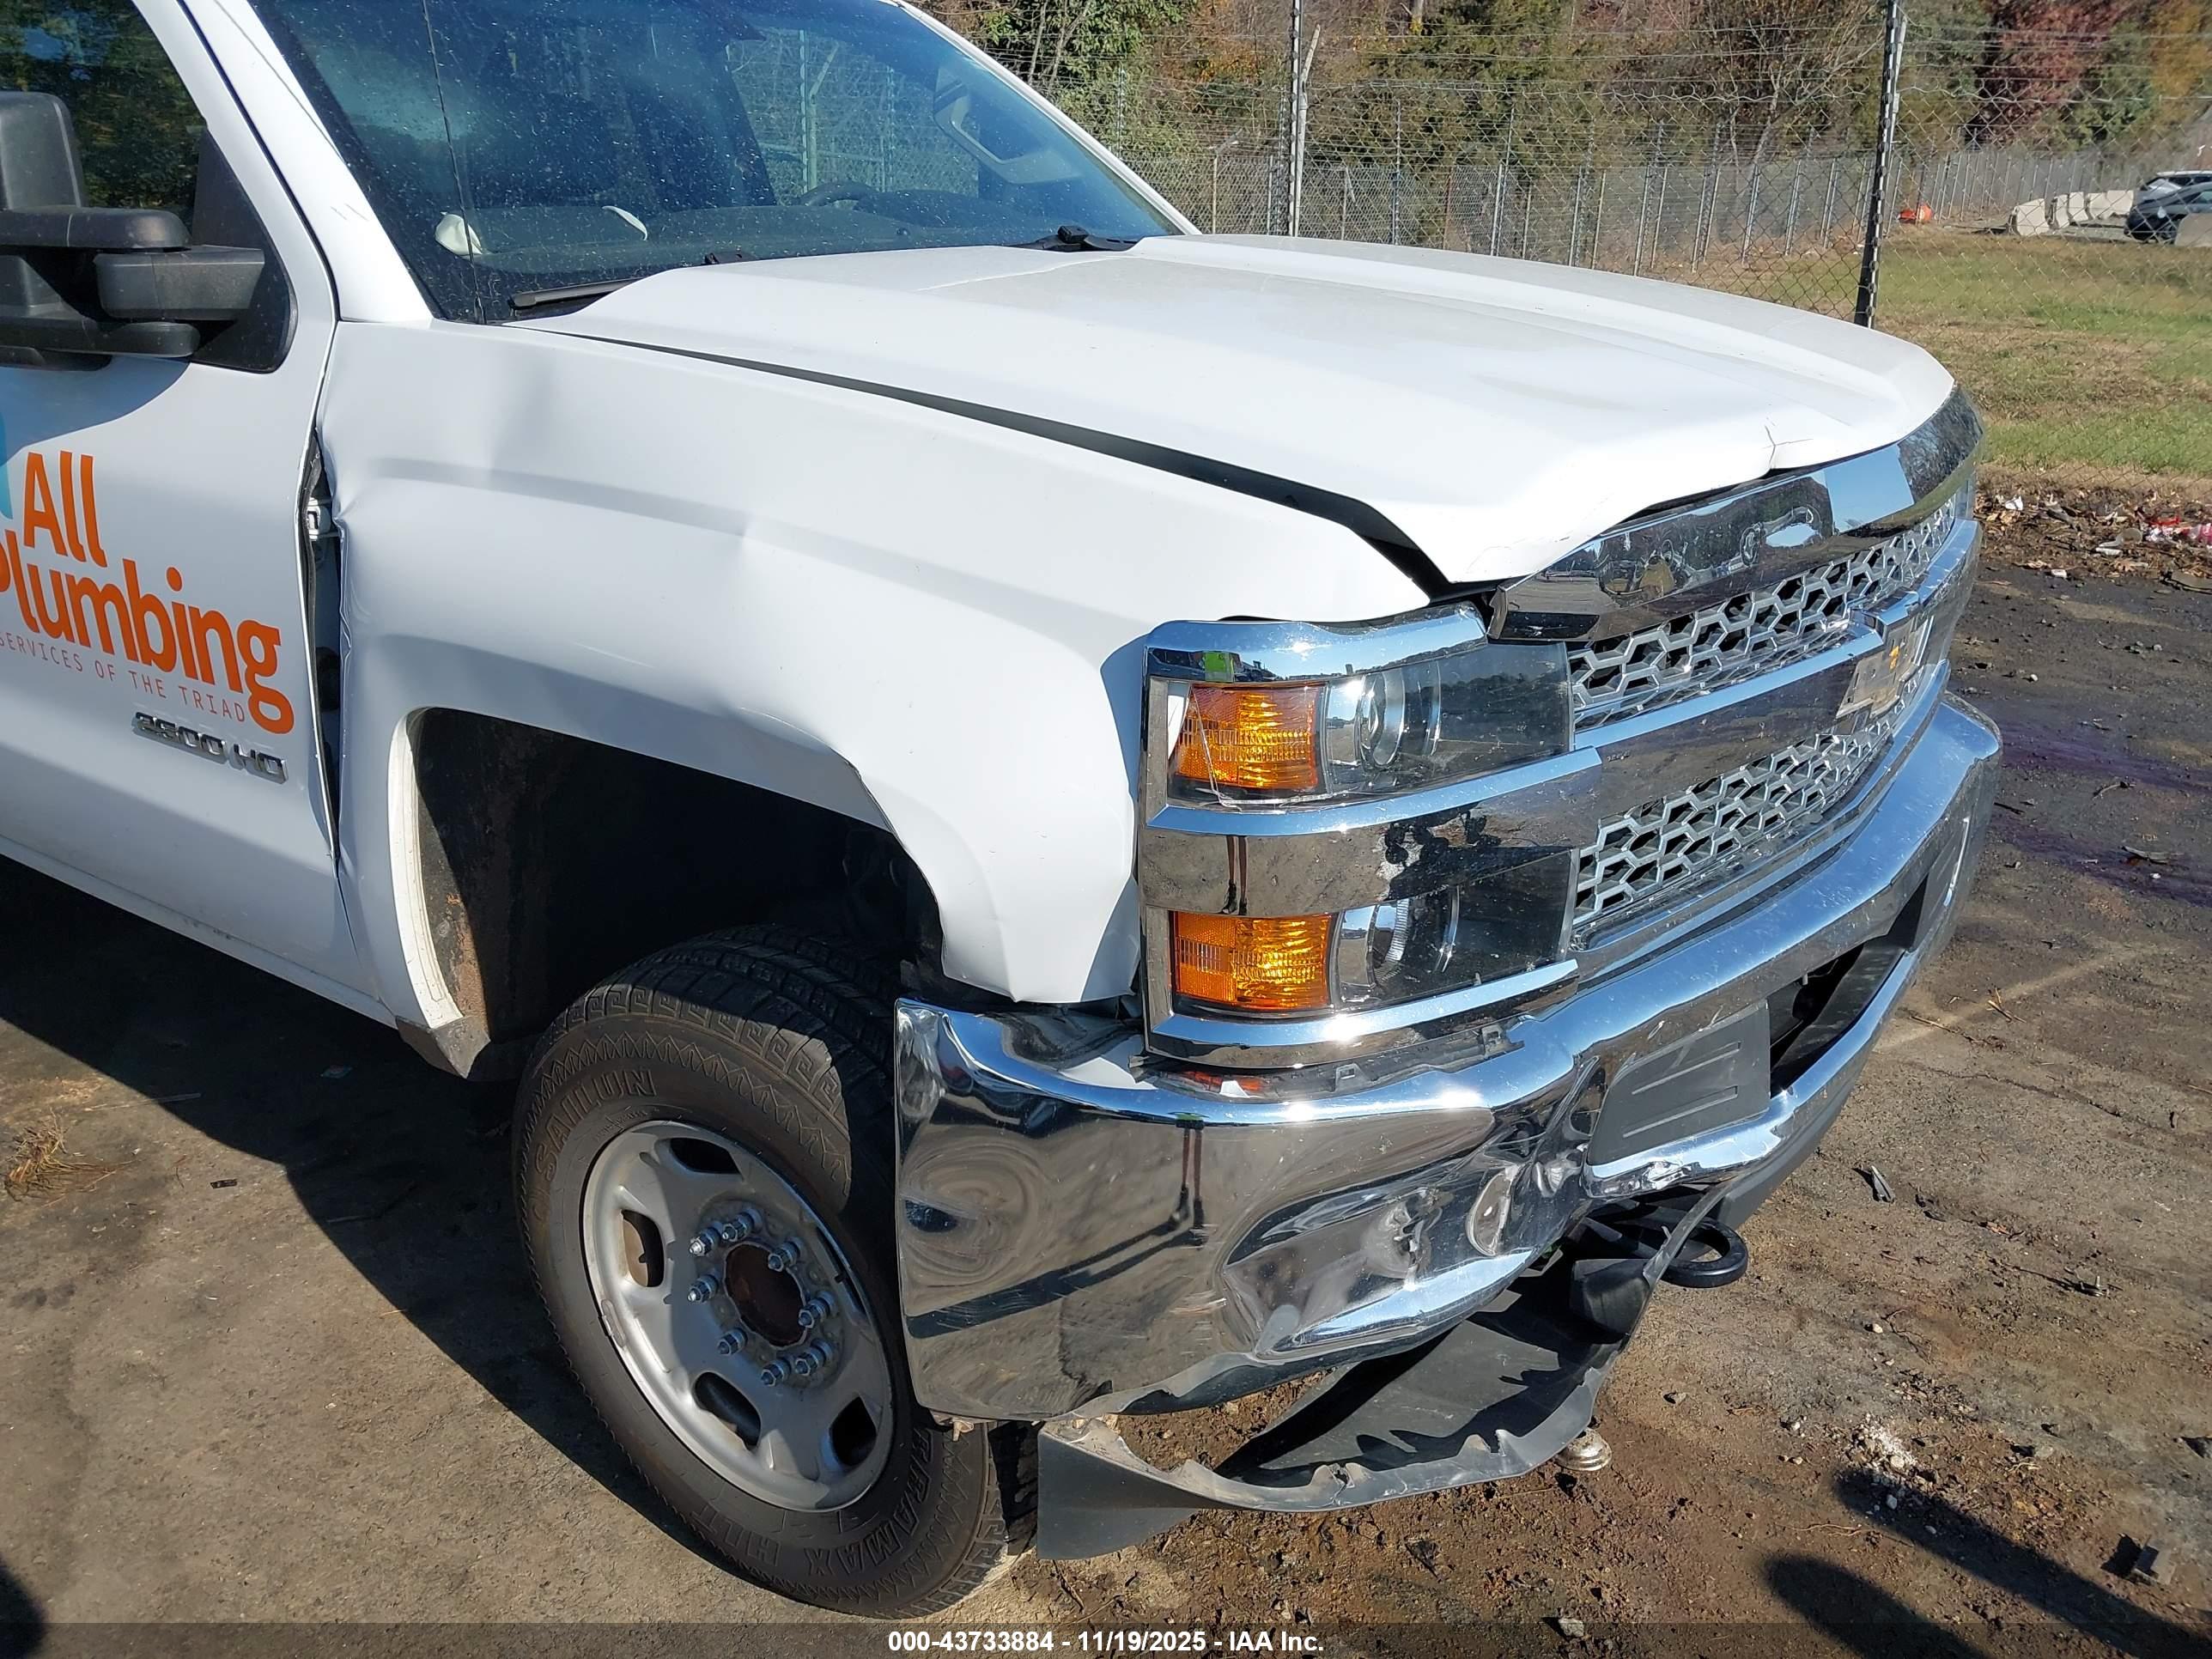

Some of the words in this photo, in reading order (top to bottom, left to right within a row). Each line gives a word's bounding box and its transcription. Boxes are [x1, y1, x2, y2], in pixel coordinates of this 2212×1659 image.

[23, 450, 108, 568] All
[94, 659, 115, 681] OF
[129, 670, 167, 698] THE
[179, 685, 246, 722] TRIAD
[533, 1068, 659, 1182] SAILUN
